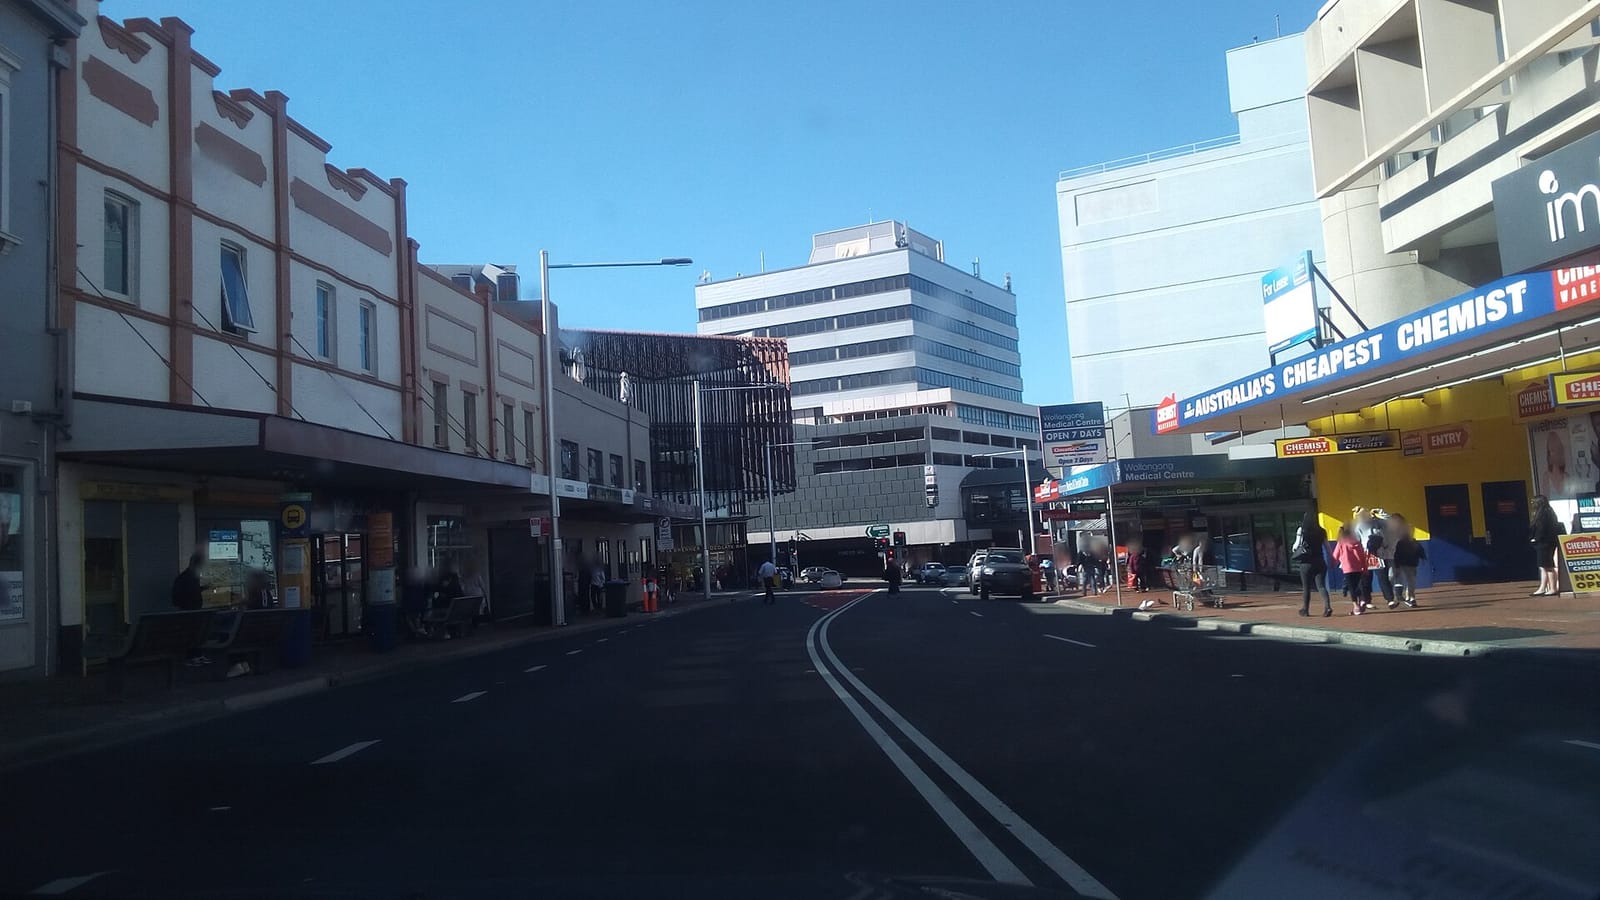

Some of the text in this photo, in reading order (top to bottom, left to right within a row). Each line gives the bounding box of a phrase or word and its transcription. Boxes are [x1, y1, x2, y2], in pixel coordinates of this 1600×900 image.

[1557, 265, 1600, 286] CHE
[1263, 283, 1273, 298] For
[1273, 275, 1289, 293] Lease
[1195, 280, 1527, 417] AUSTRALIA'S CHEAPEST CHEMIST
[1519, 389, 1552, 407] CHEMIST
[1043, 412, 1085, 421] Wollongong
[1044, 418, 1102, 429] Medical Centre
[1046, 429, 1102, 441] OPEN 7 DAYS
[1431, 431, 1462, 447] ENTRY
[1286, 442, 1327, 451] CHEMIST
[1124, 462, 1174, 472] Wollongong
[1125, 470, 1195, 481] Medical Centre
[1566, 540, 1600, 549] CHEMIST
